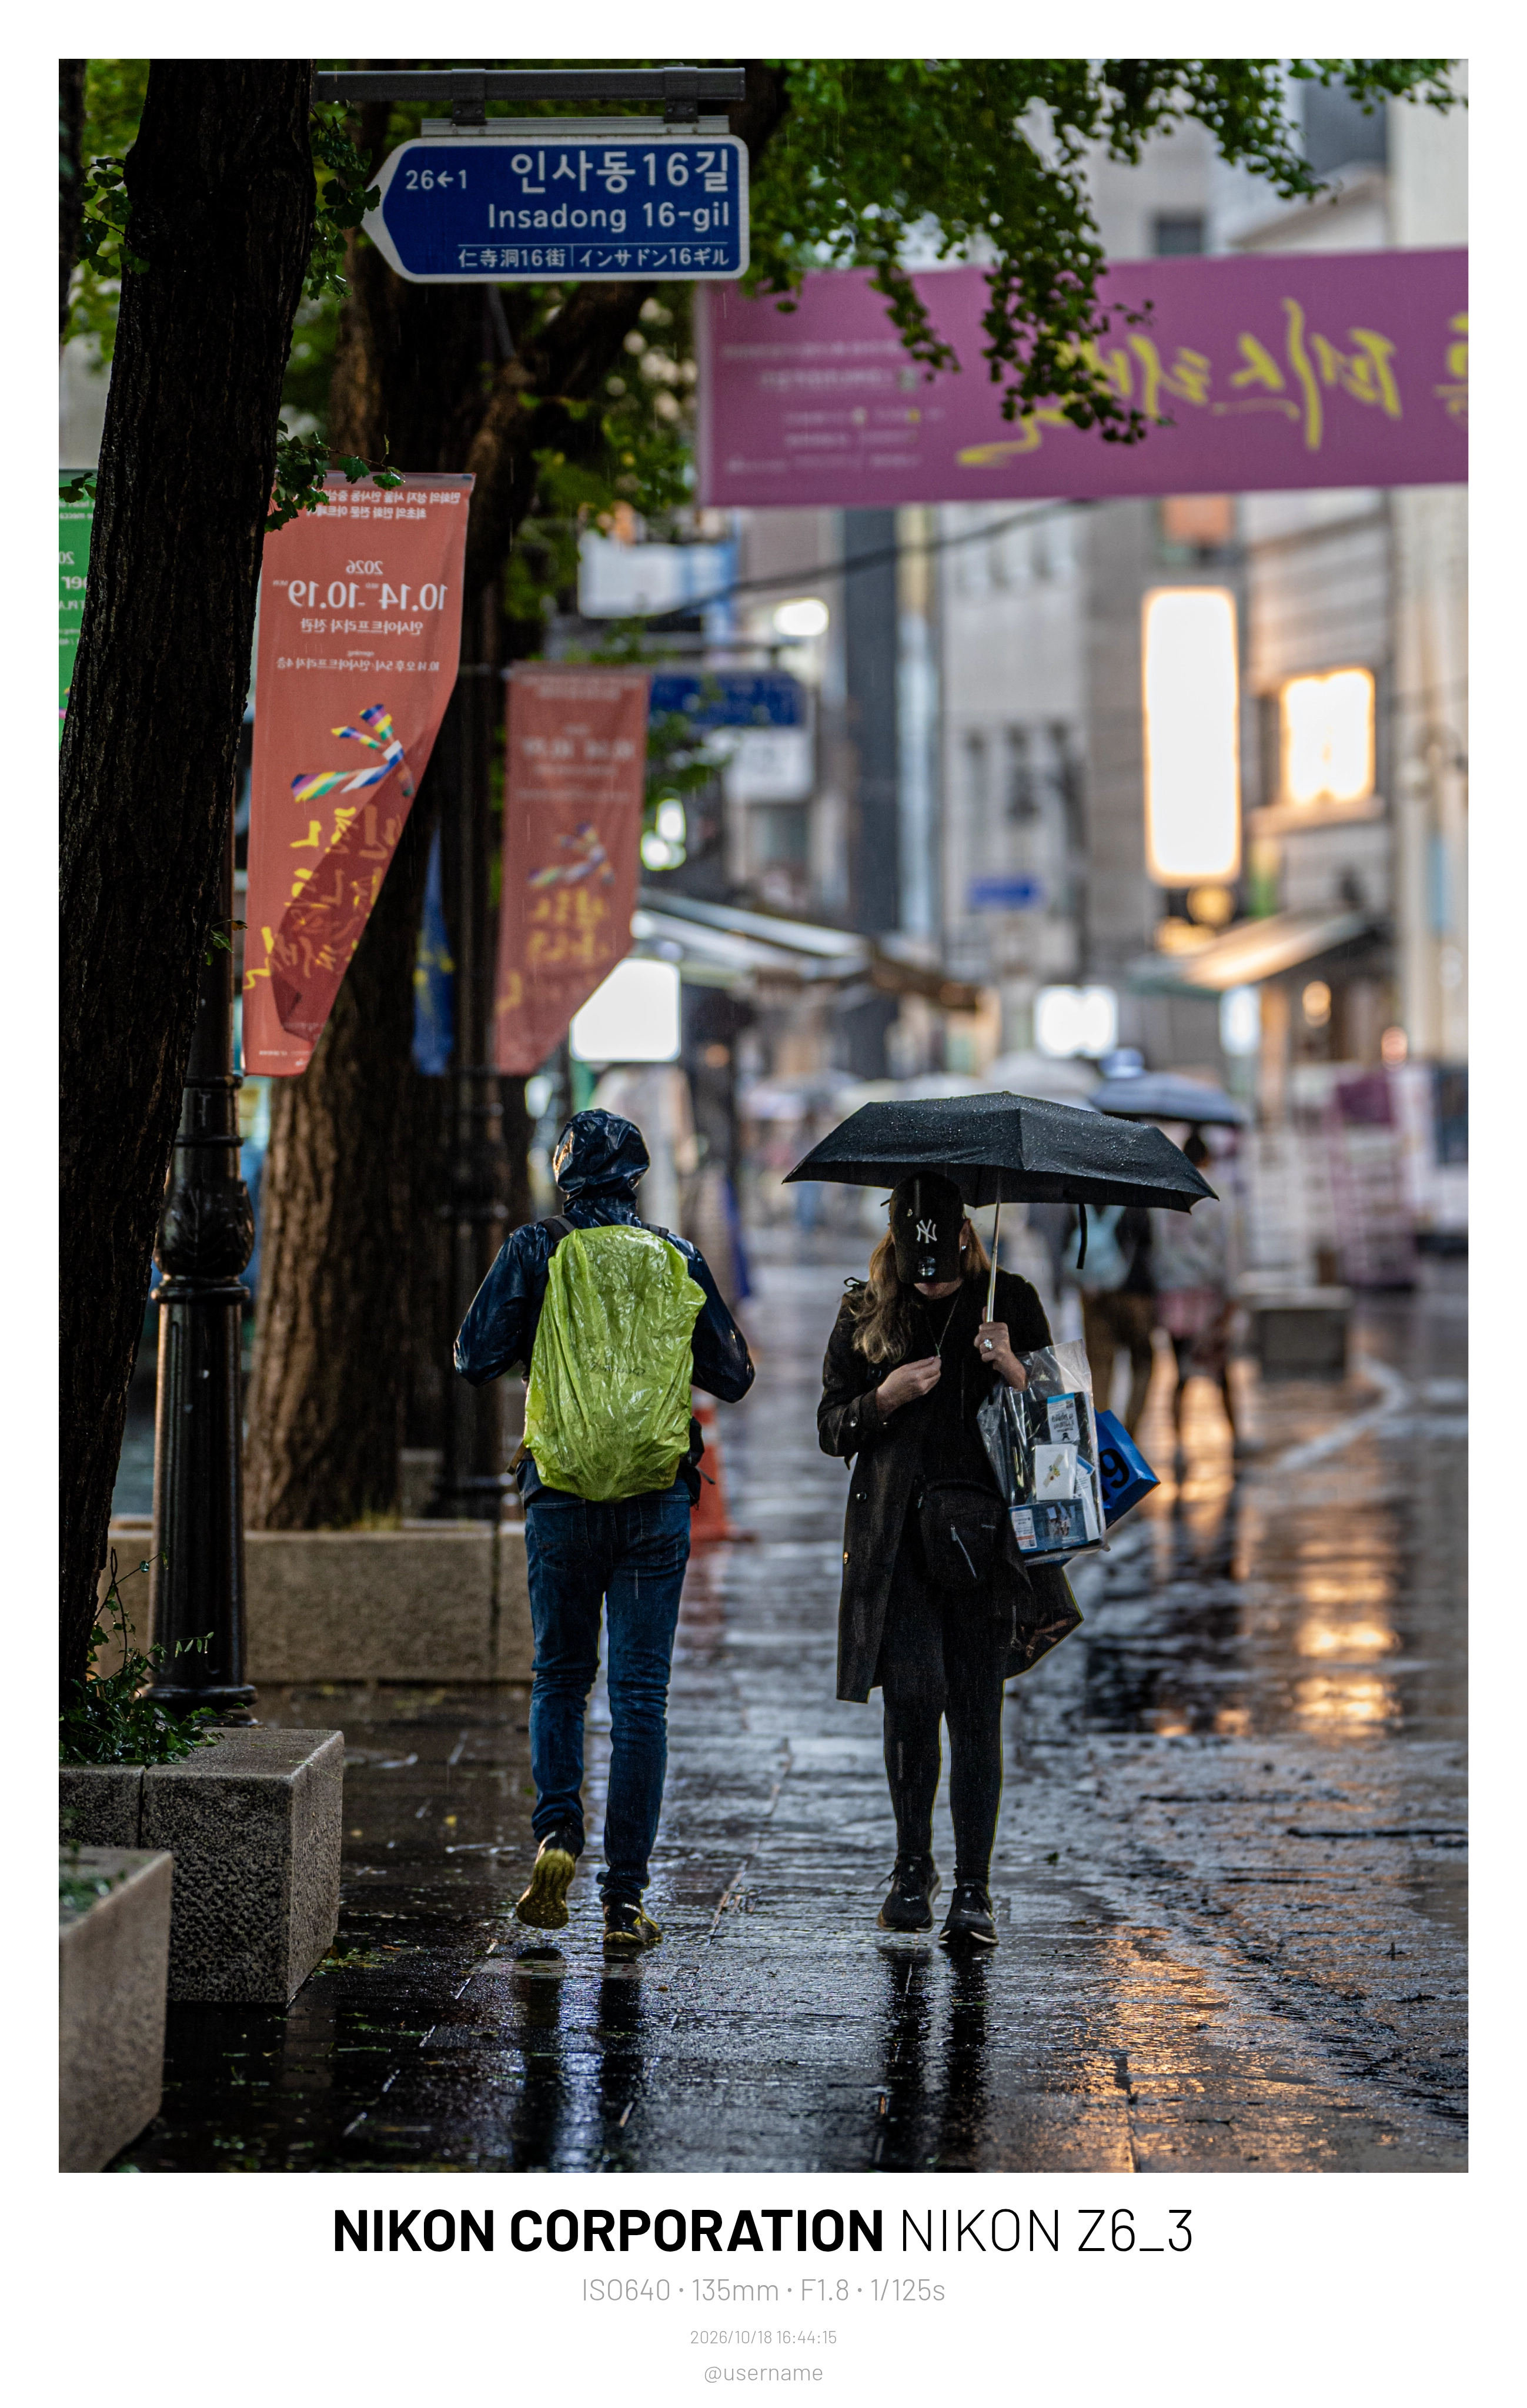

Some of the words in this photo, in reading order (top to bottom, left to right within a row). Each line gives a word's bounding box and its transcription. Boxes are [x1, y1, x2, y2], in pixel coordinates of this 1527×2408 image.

[489, 203, 626, 233] Insadong
[643, 201, 729, 232] 16-gil
[459, 248, 566, 268] 仁寺洞16街
[579, 248, 729, 267] インサドン16ギル
[916, 1218, 938, 1244] NY
